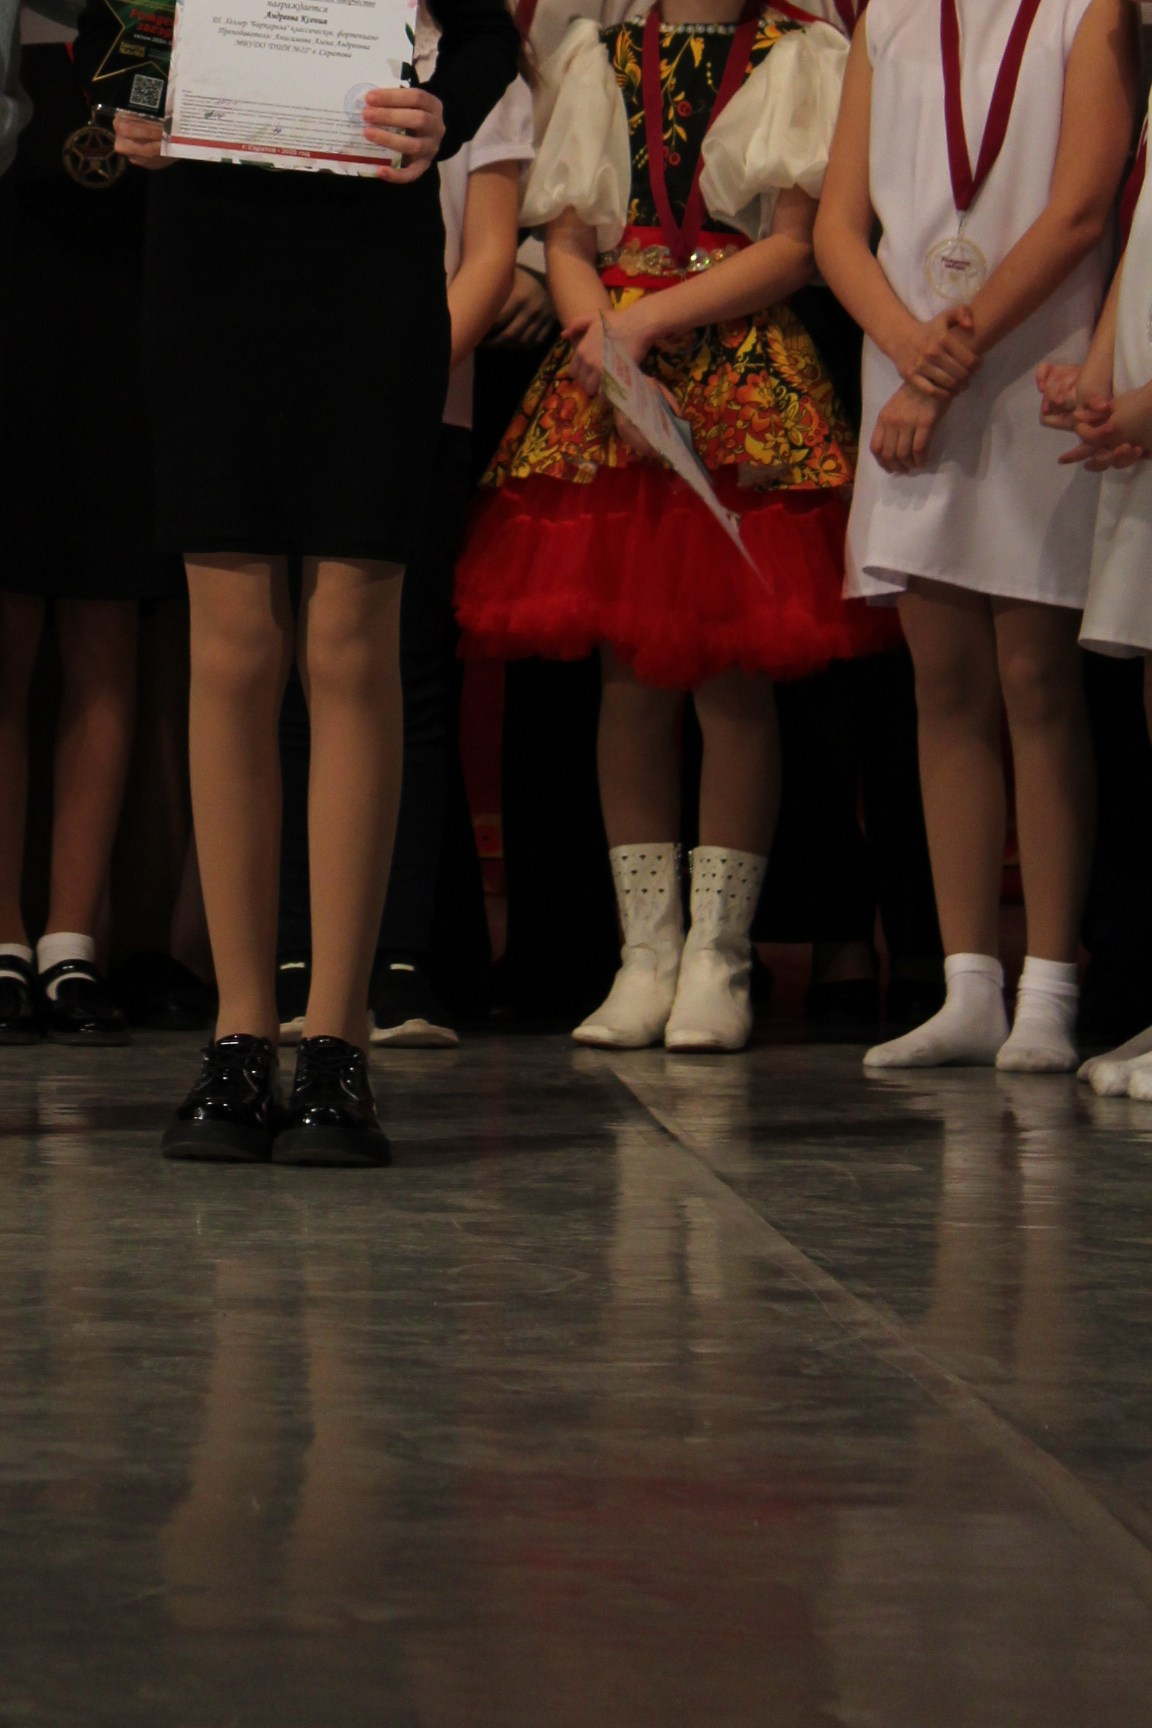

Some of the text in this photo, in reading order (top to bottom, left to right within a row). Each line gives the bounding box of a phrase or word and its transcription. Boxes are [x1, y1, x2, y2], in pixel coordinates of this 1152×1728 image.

[267, 0, 328, 13] награждается
[263, 11, 328, 24] Андреева Ксения
[248, 144, 276, 154] Саратов
